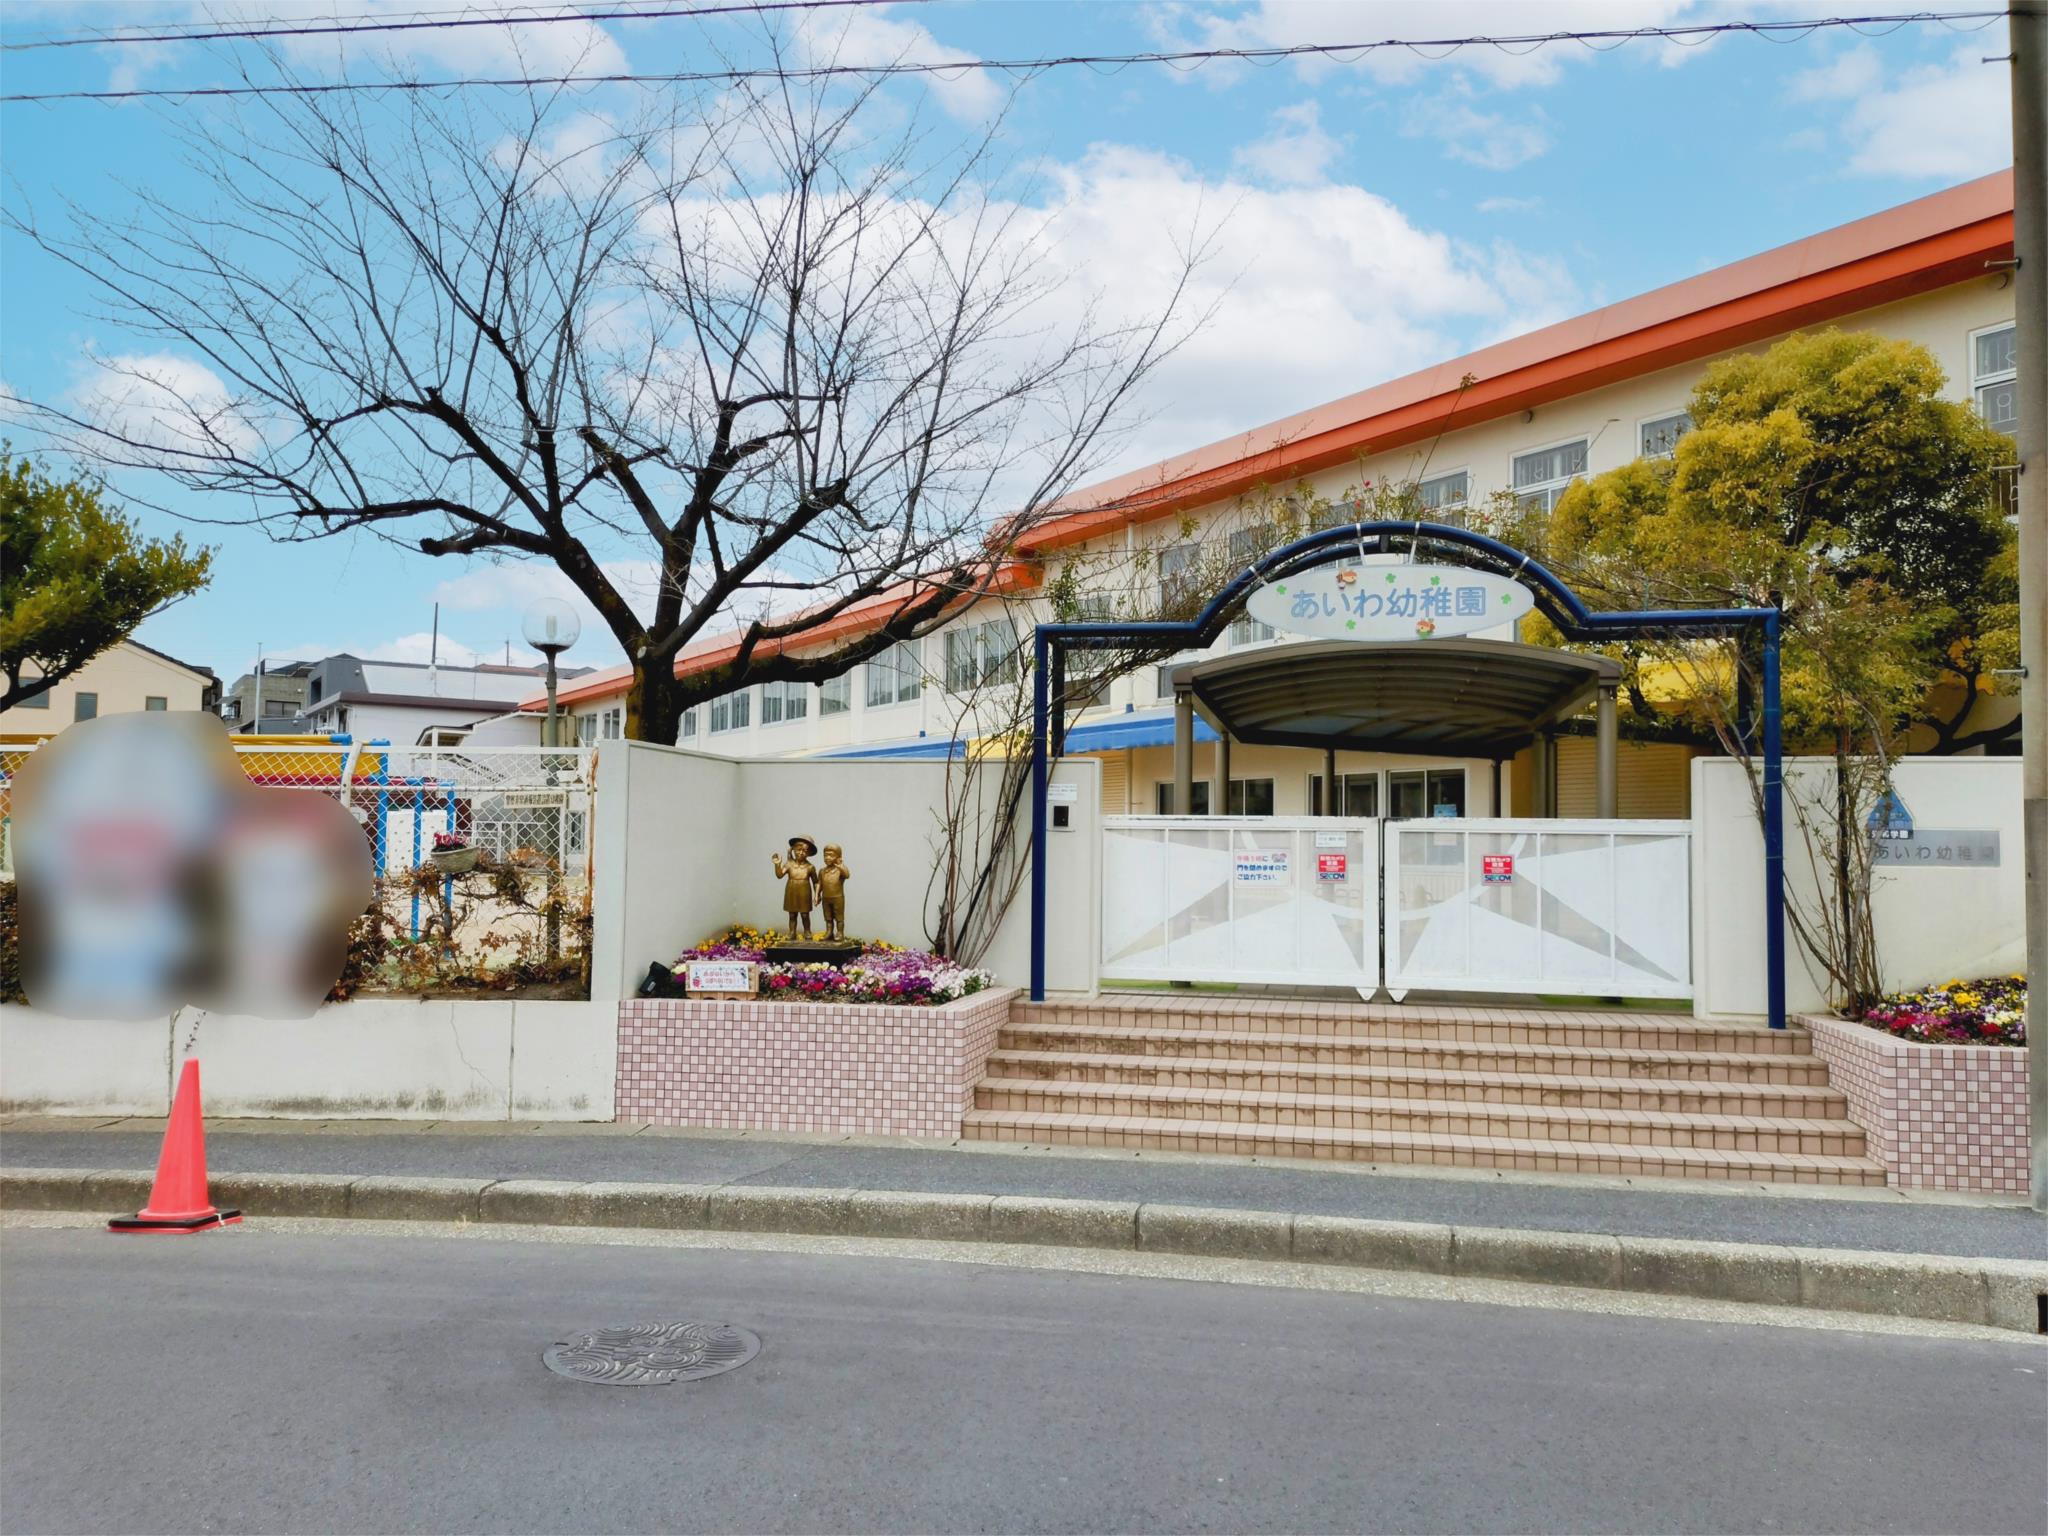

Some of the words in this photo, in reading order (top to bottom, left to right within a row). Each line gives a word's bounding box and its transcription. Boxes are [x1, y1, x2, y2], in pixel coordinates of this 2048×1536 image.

[1290, 586, 1486, 618] あいわ幼稚園
[1319, 872, 1345, 880] SECOM
